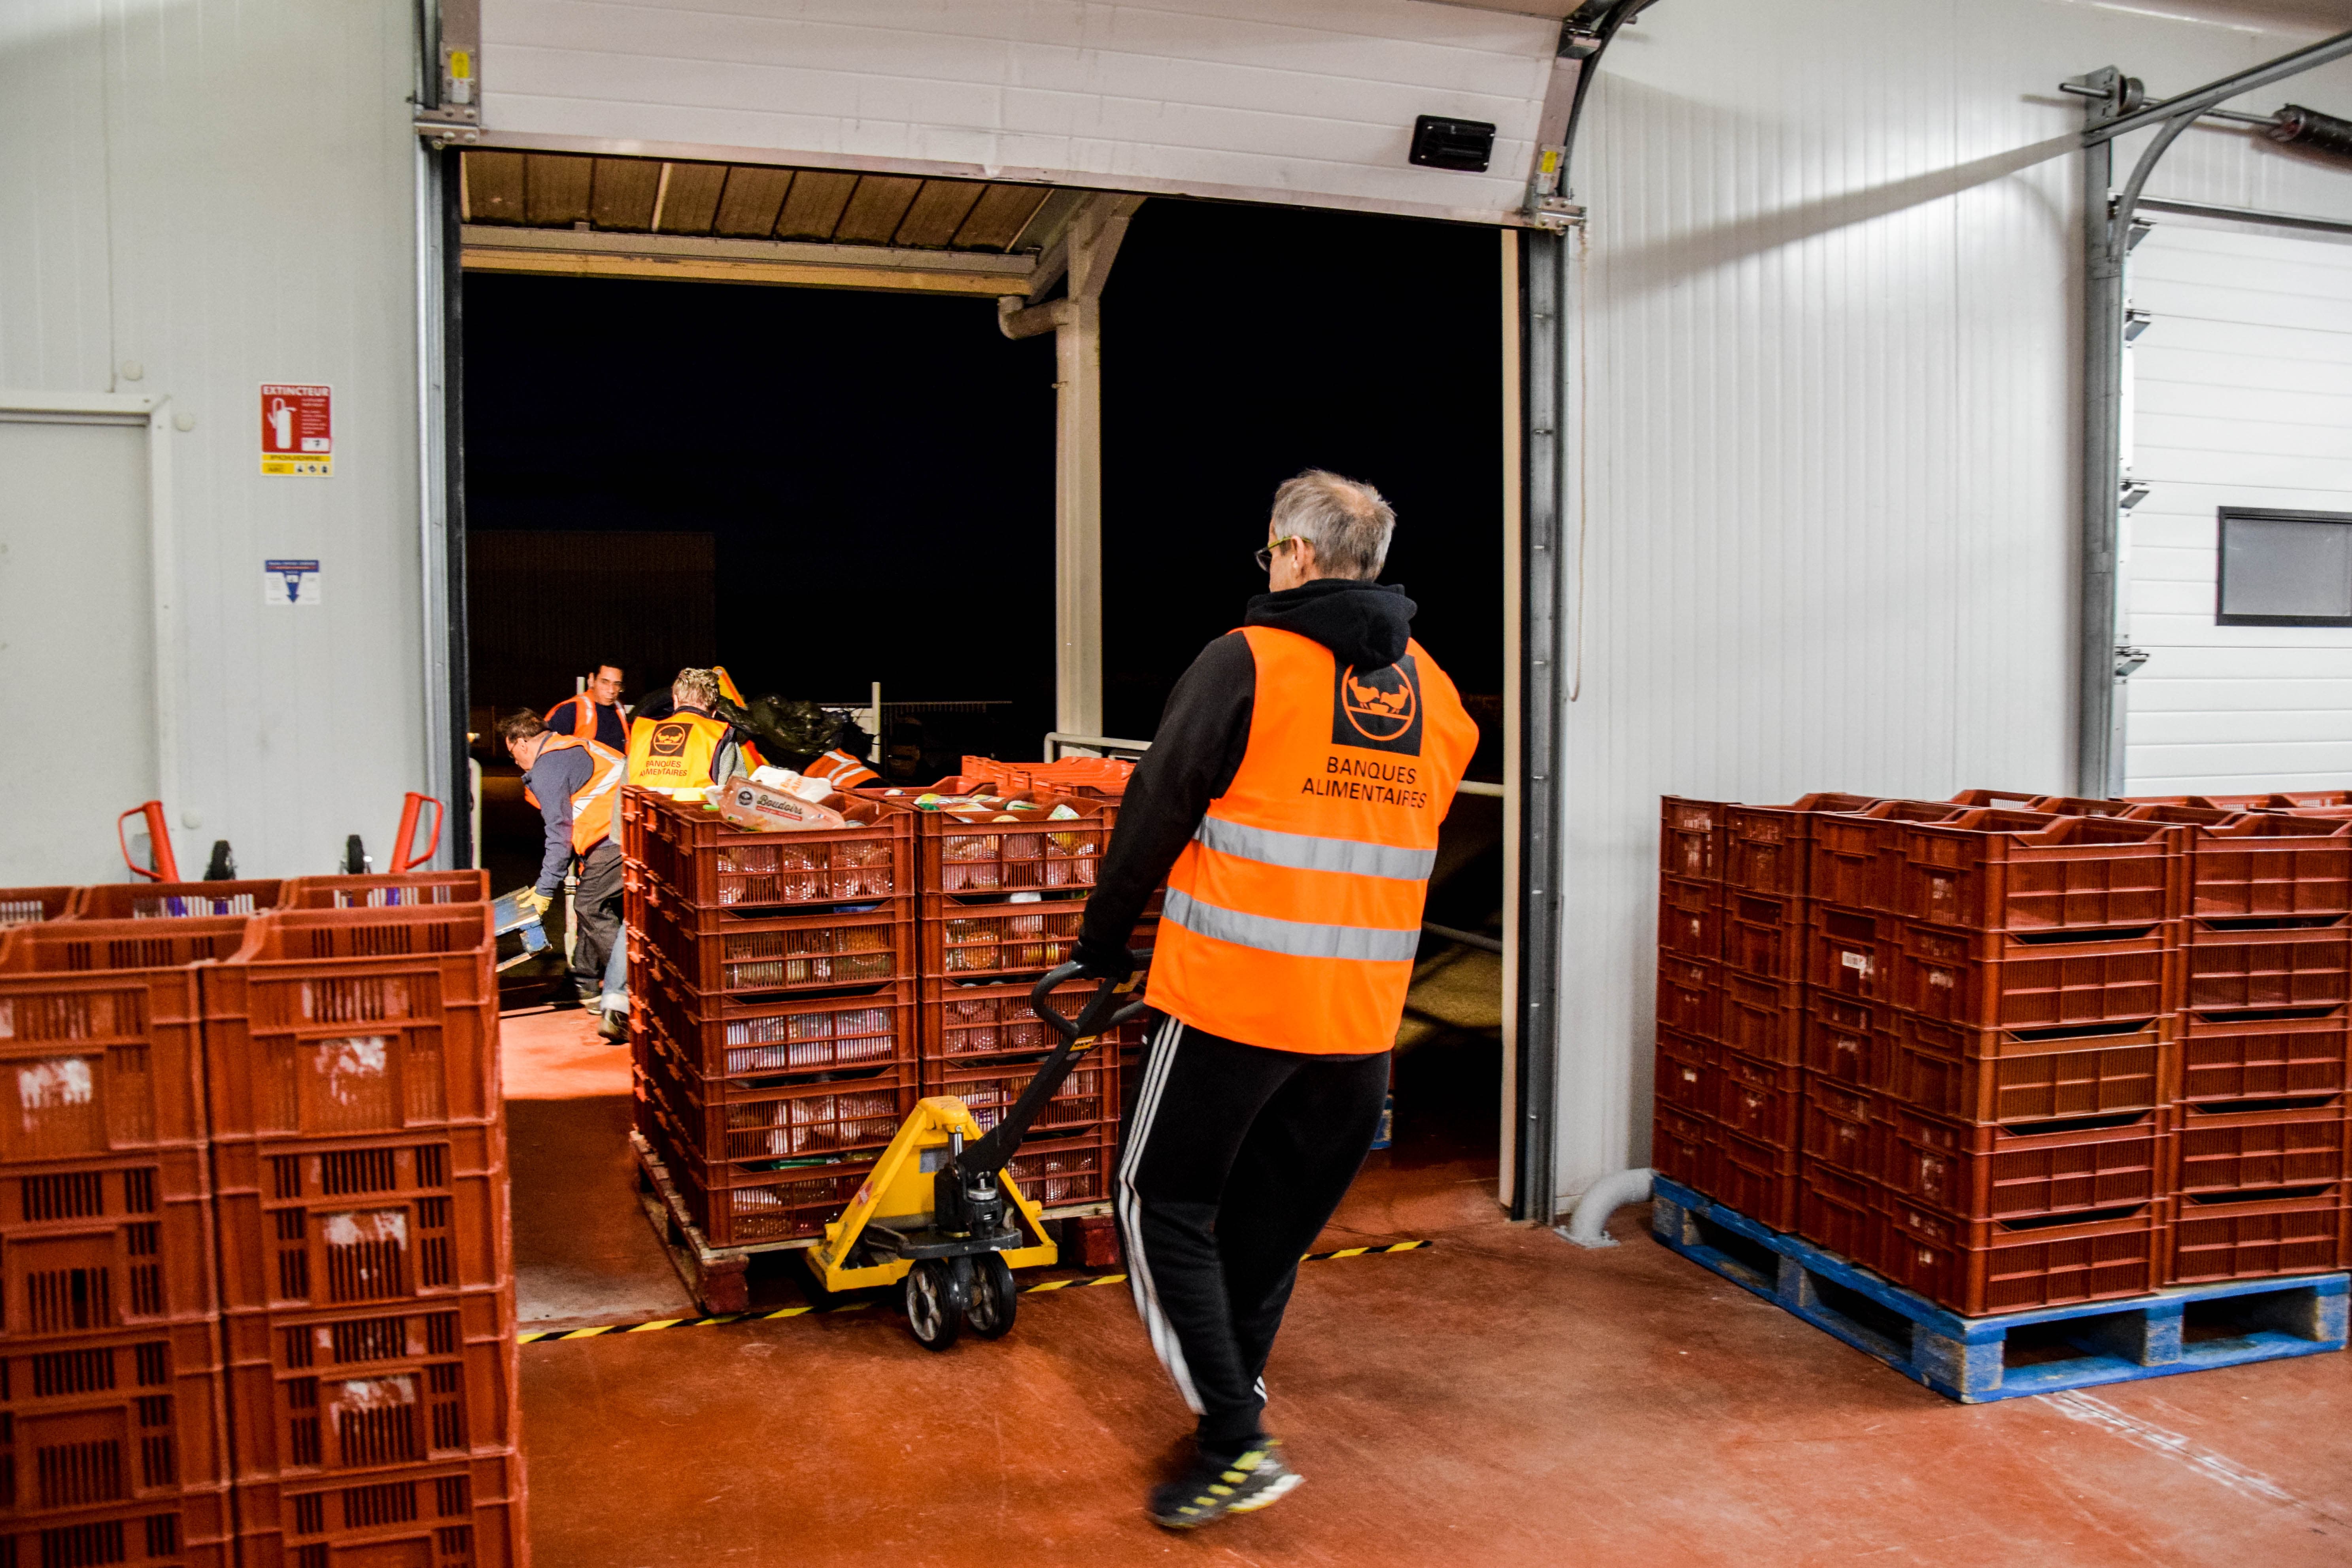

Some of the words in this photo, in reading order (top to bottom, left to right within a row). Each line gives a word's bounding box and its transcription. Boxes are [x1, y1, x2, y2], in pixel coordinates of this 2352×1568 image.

[263, 386, 329, 396] EXTINCTEUR
[639, 768, 688, 777] AIMENTAIRES
[1326, 756, 1417, 784] BANQUES
[1301, 777, 1427, 809] ALIMENTAIRES
[756, 794, 803, 814] Boudoirs
